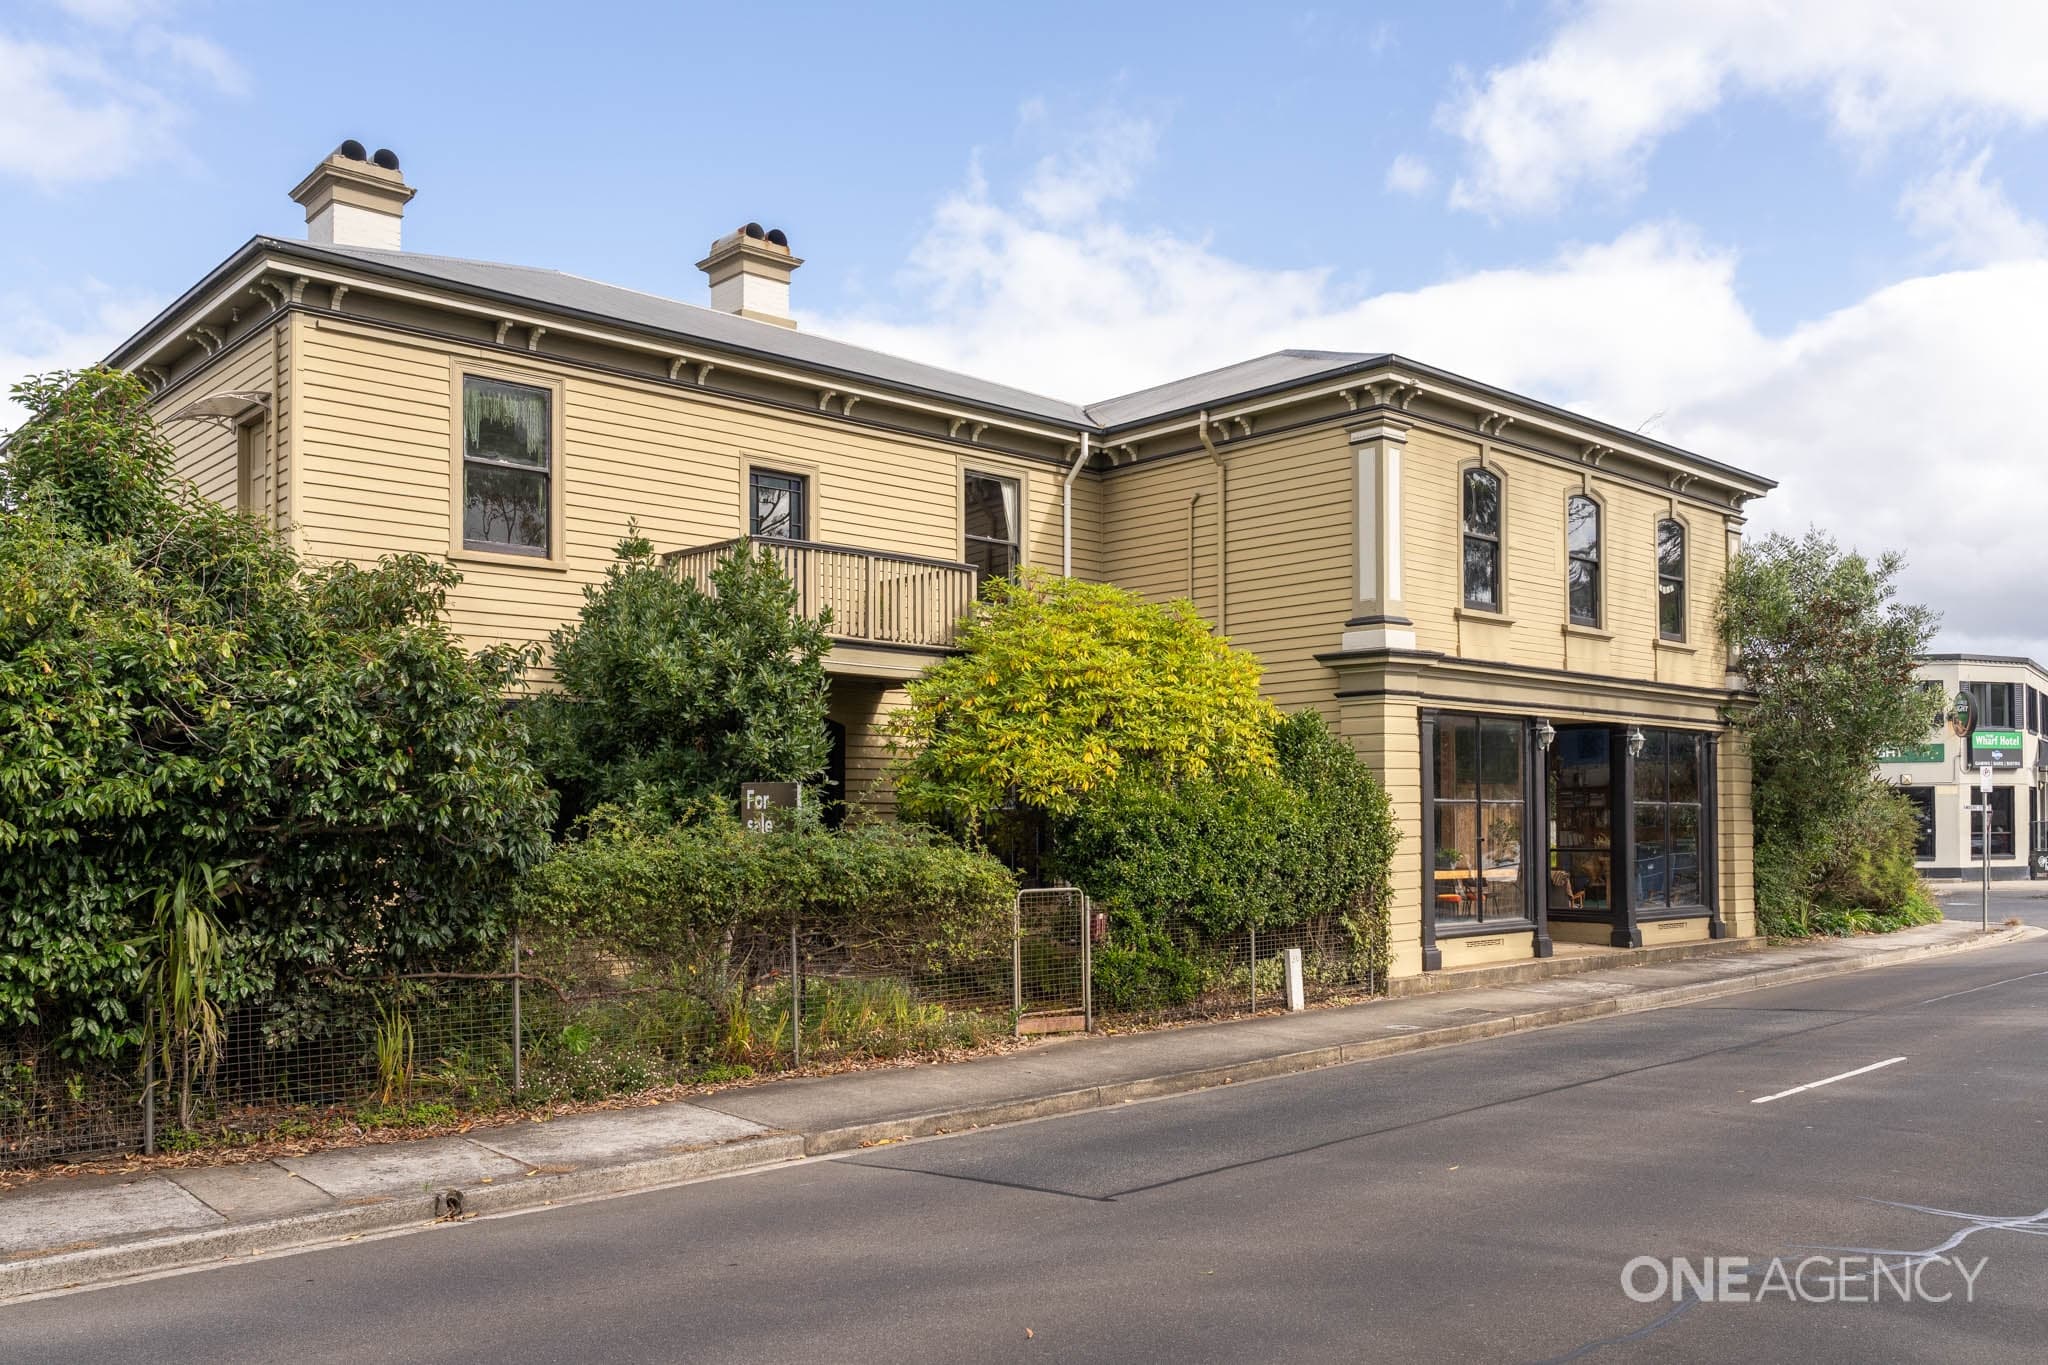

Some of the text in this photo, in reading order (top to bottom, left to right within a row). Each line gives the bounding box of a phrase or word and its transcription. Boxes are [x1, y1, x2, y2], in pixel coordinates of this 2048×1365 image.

[1976, 735, 2019, 745] Wharf Hotel
[746, 789, 769, 809] For
